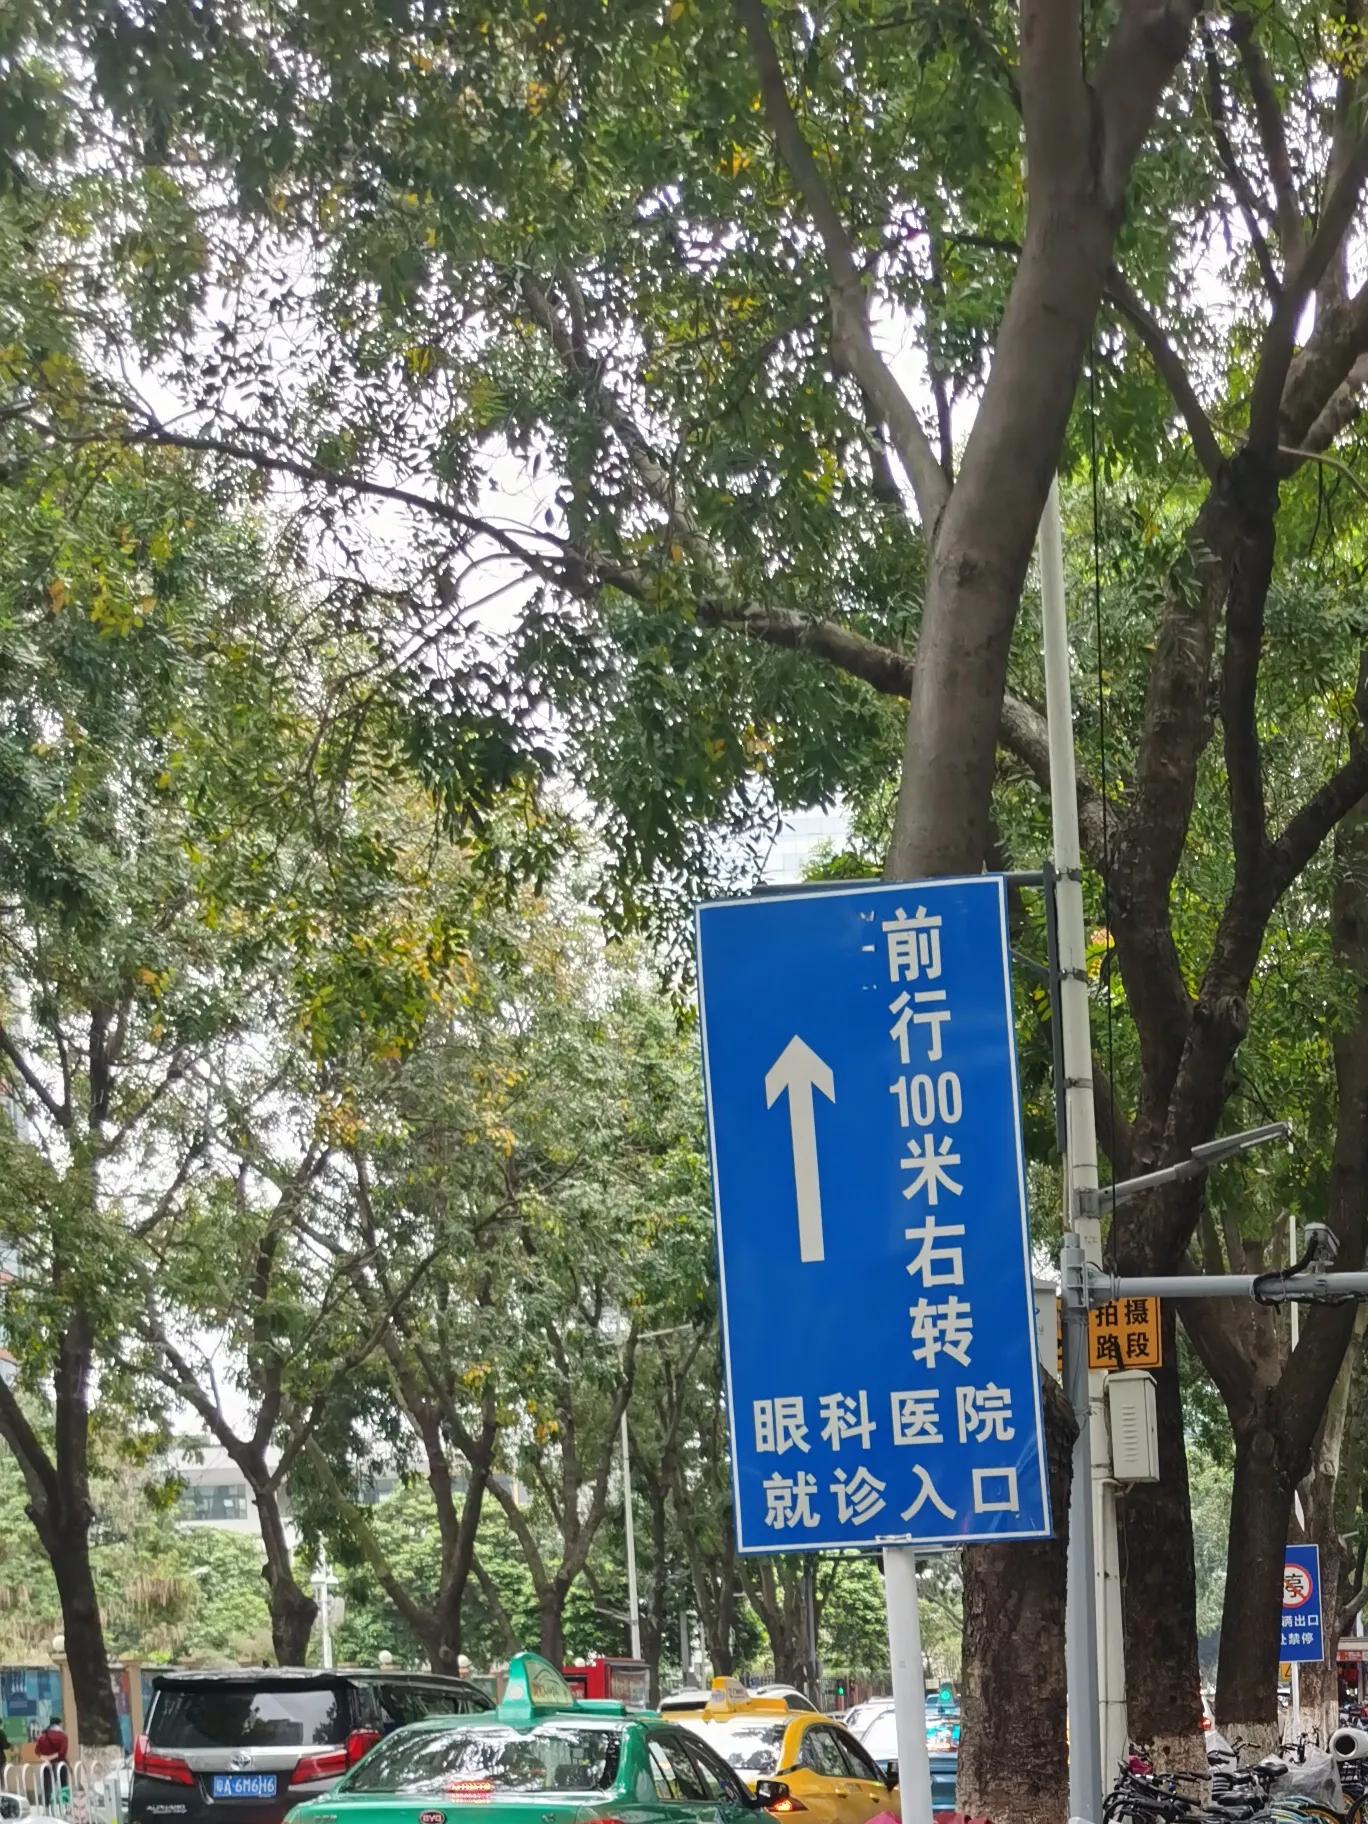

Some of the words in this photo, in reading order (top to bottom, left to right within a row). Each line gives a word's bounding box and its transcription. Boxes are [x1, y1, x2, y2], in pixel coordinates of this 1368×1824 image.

[882, 906, 973, 1368] 前行100米右转
[1095, 1299, 1149, 1327] 拍摄
[1096, 1332, 1150, 1359] 路段
[753, 1383, 1016, 1454] 眼科医院
[763, 1464, 1019, 1529] 就诊入口
